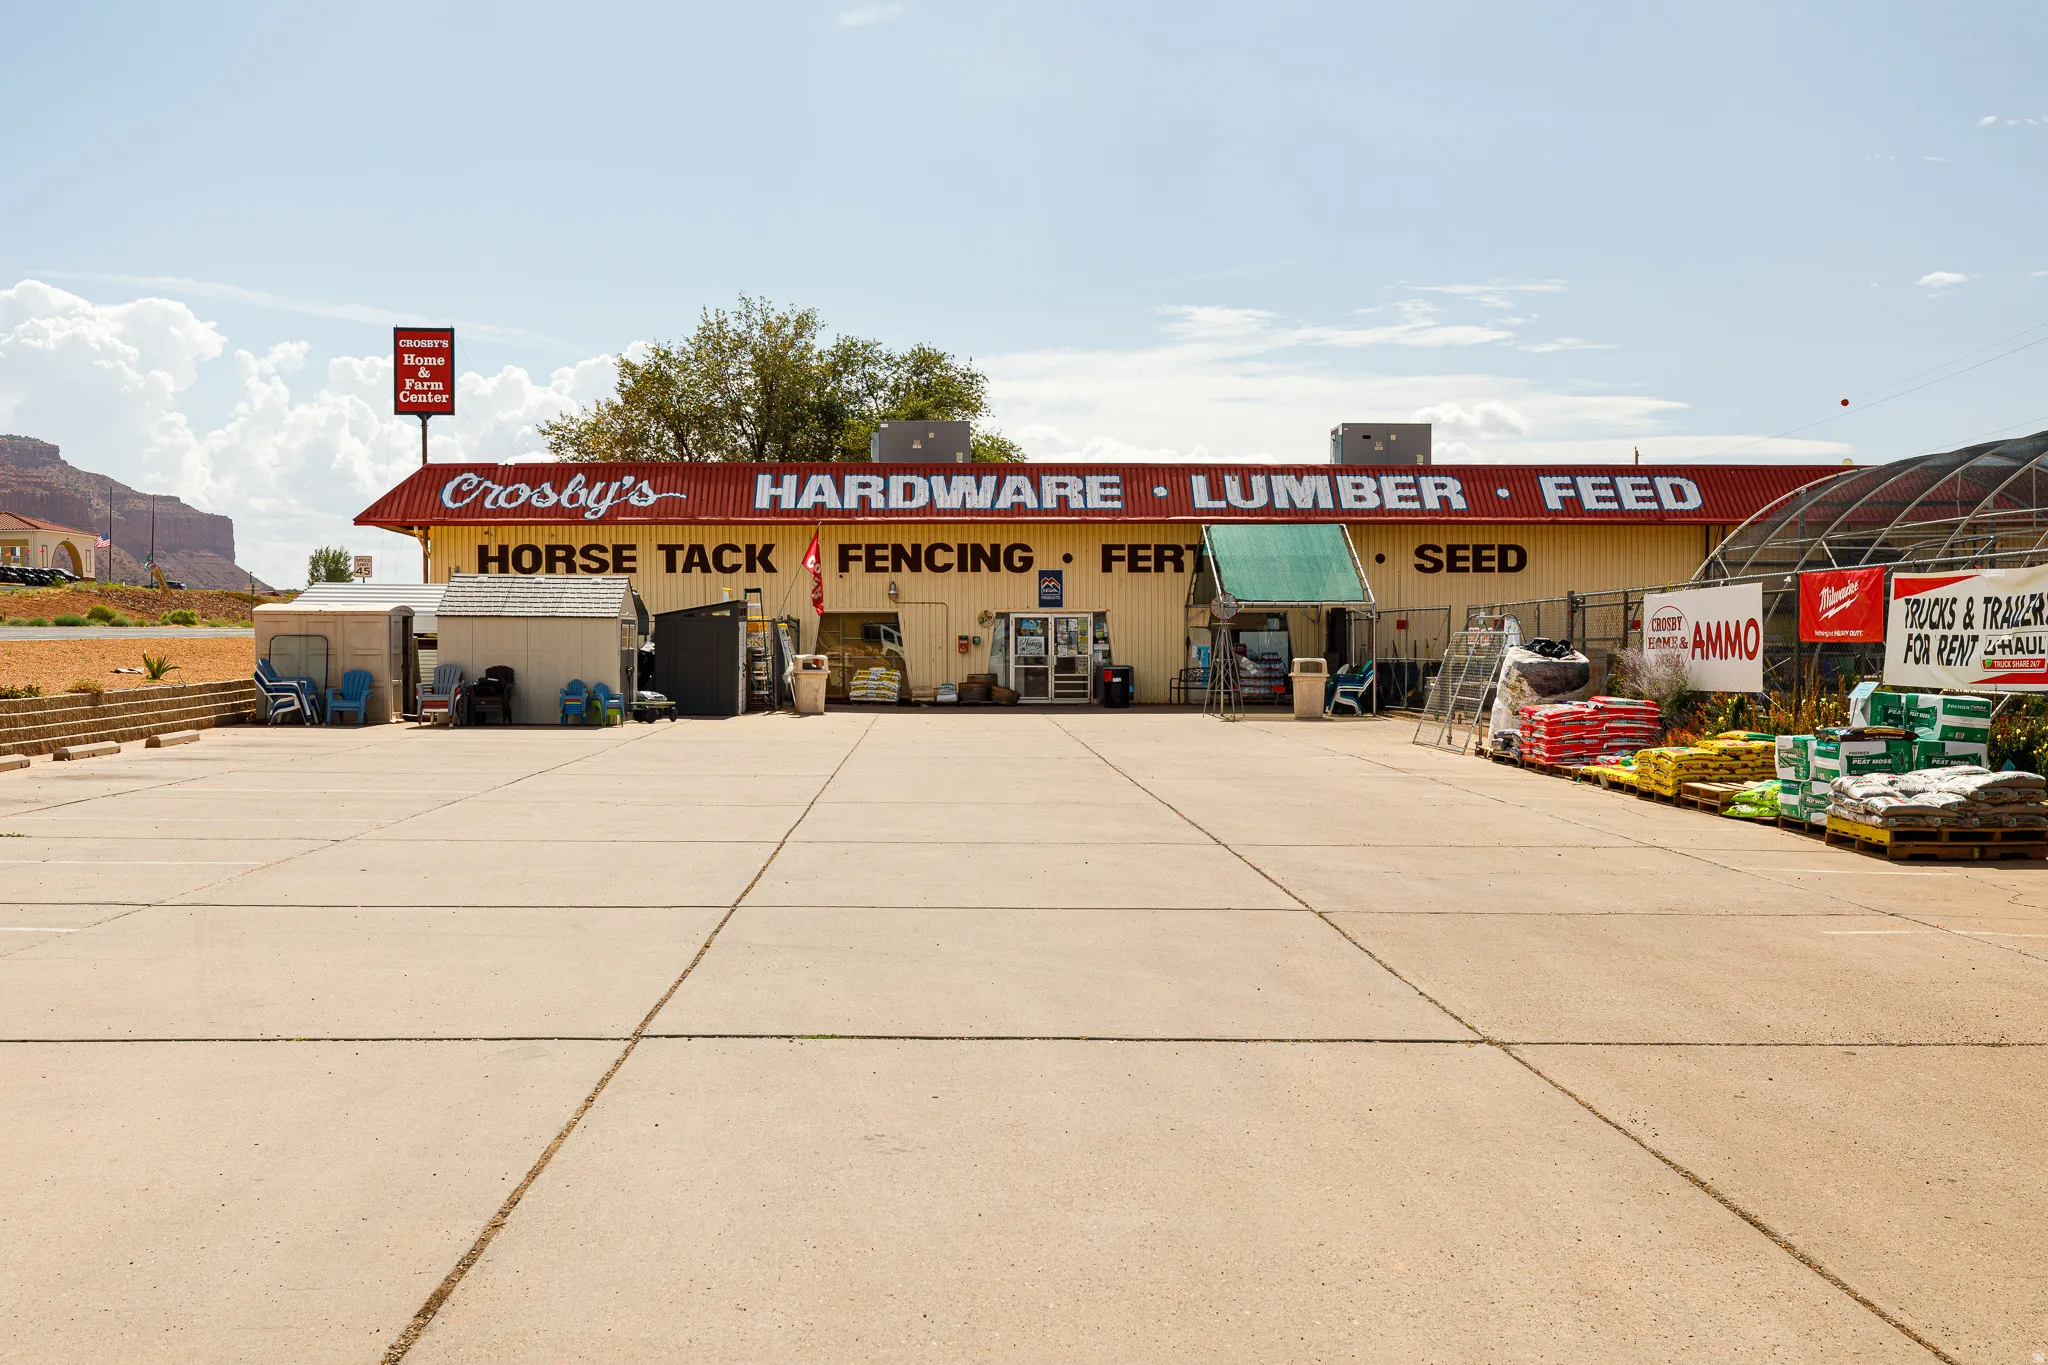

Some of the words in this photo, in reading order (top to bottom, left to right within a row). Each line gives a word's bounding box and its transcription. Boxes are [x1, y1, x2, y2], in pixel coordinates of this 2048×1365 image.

[399, 339, 449, 348] CROSBY'S
[403, 354, 445, 366] Home
[418, 366, 431, 378] &
[404, 379, 444, 390] Farm
[399, 391, 449, 403] Center
[440, 472, 687, 520] Crosby's
[753, 473, 1123, 510] HARDWARE
[1190, 474, 1468, 510] LUMBER
[1538, 475, 1704, 511] FEED
[477, 543, 637, 574] HORSE
[657, 544, 779, 573] TACK
[838, 542, 1034, 574] FENCING
[1413, 543, 1528, 574] SEED
[356, 567, 370, 575] 45
[1819, 579, 1859, 612] Milwaukee
[1905, 596, 1957, 630] TRUCKS
[1963, 596, 1975, 630] &
[1983, 592, 2048, 629] TRAILER
[1651, 616, 1682, 631] CROSBY
[1647, 636, 1678, 649] HOME
[1679, 636, 1688, 649] &
[1691, 617, 1760, 660] AMMO
[1903, 633, 1930, 665] FOR
[1937, 634, 1979, 666] RENT
[2030, 660, 2041, 668] 24/7
